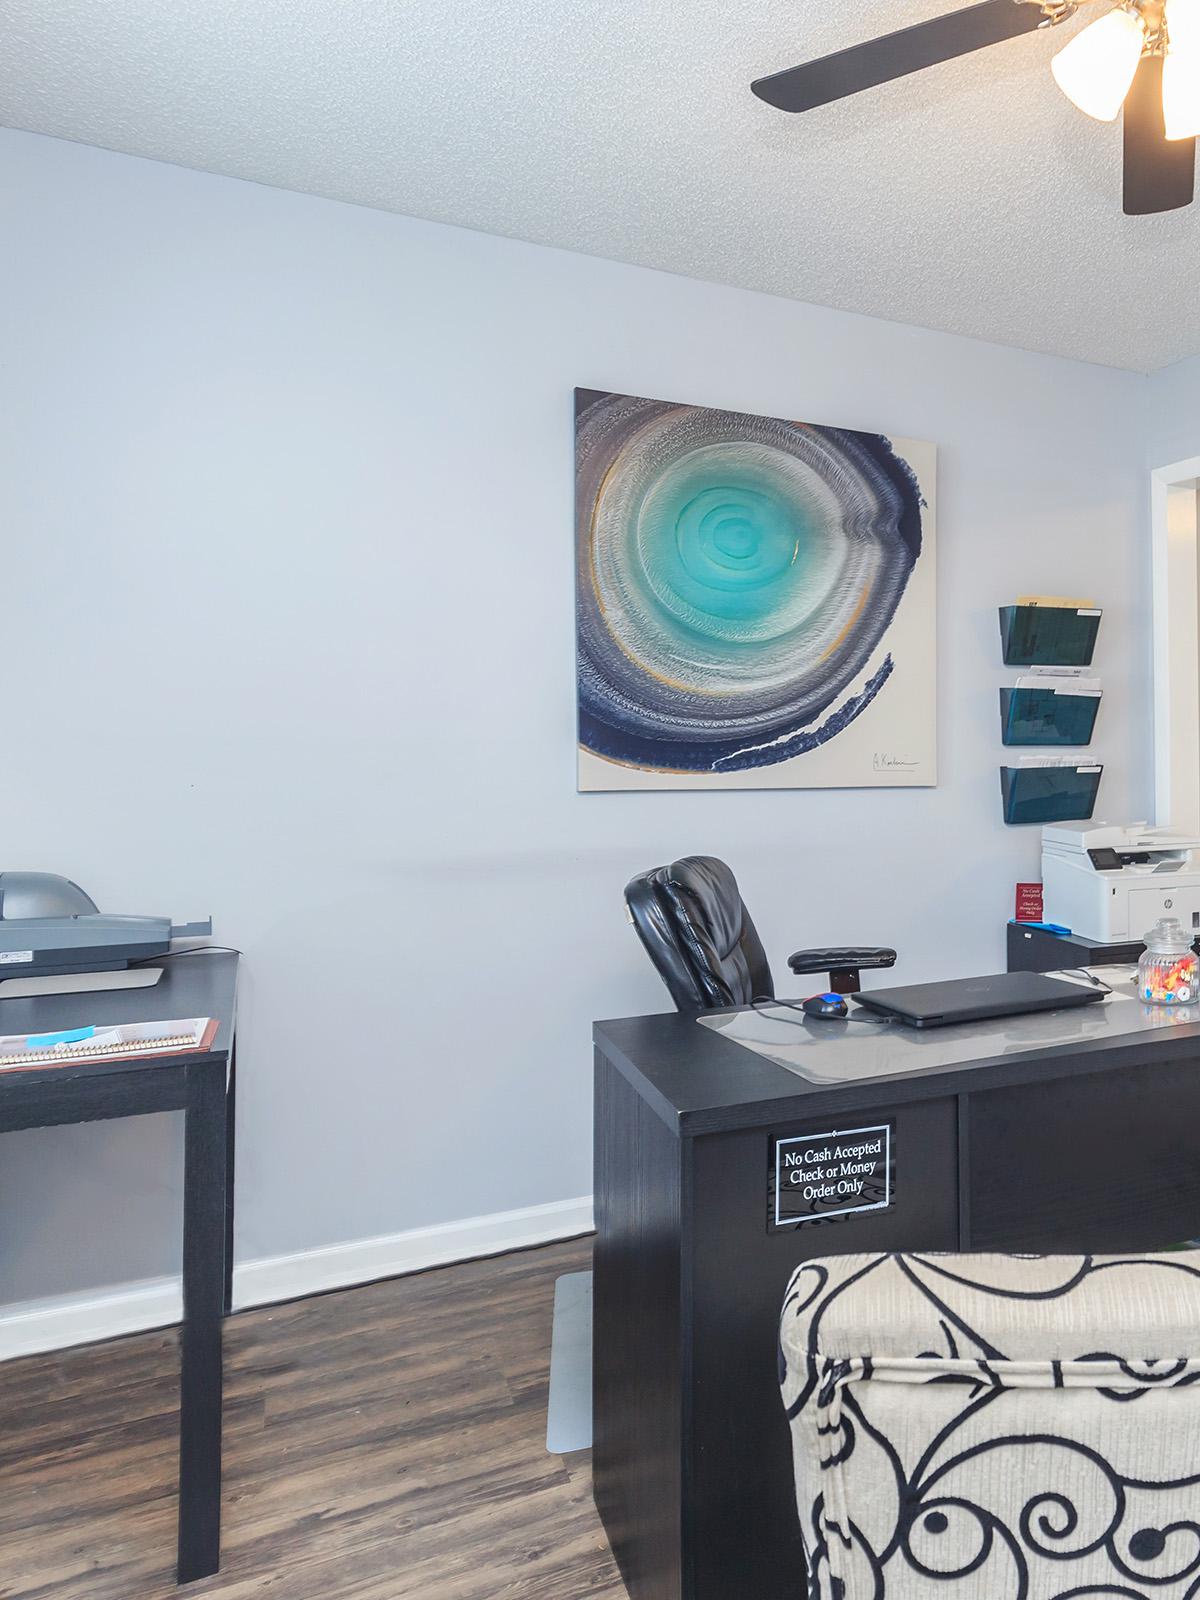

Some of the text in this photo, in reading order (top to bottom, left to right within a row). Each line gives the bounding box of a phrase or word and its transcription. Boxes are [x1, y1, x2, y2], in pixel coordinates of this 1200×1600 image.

[785, 1140, 881, 1167] No Cash Accepted
[790, 1160, 876, 1184] Check or Money
[803, 1179, 864, 1199] Order Only
